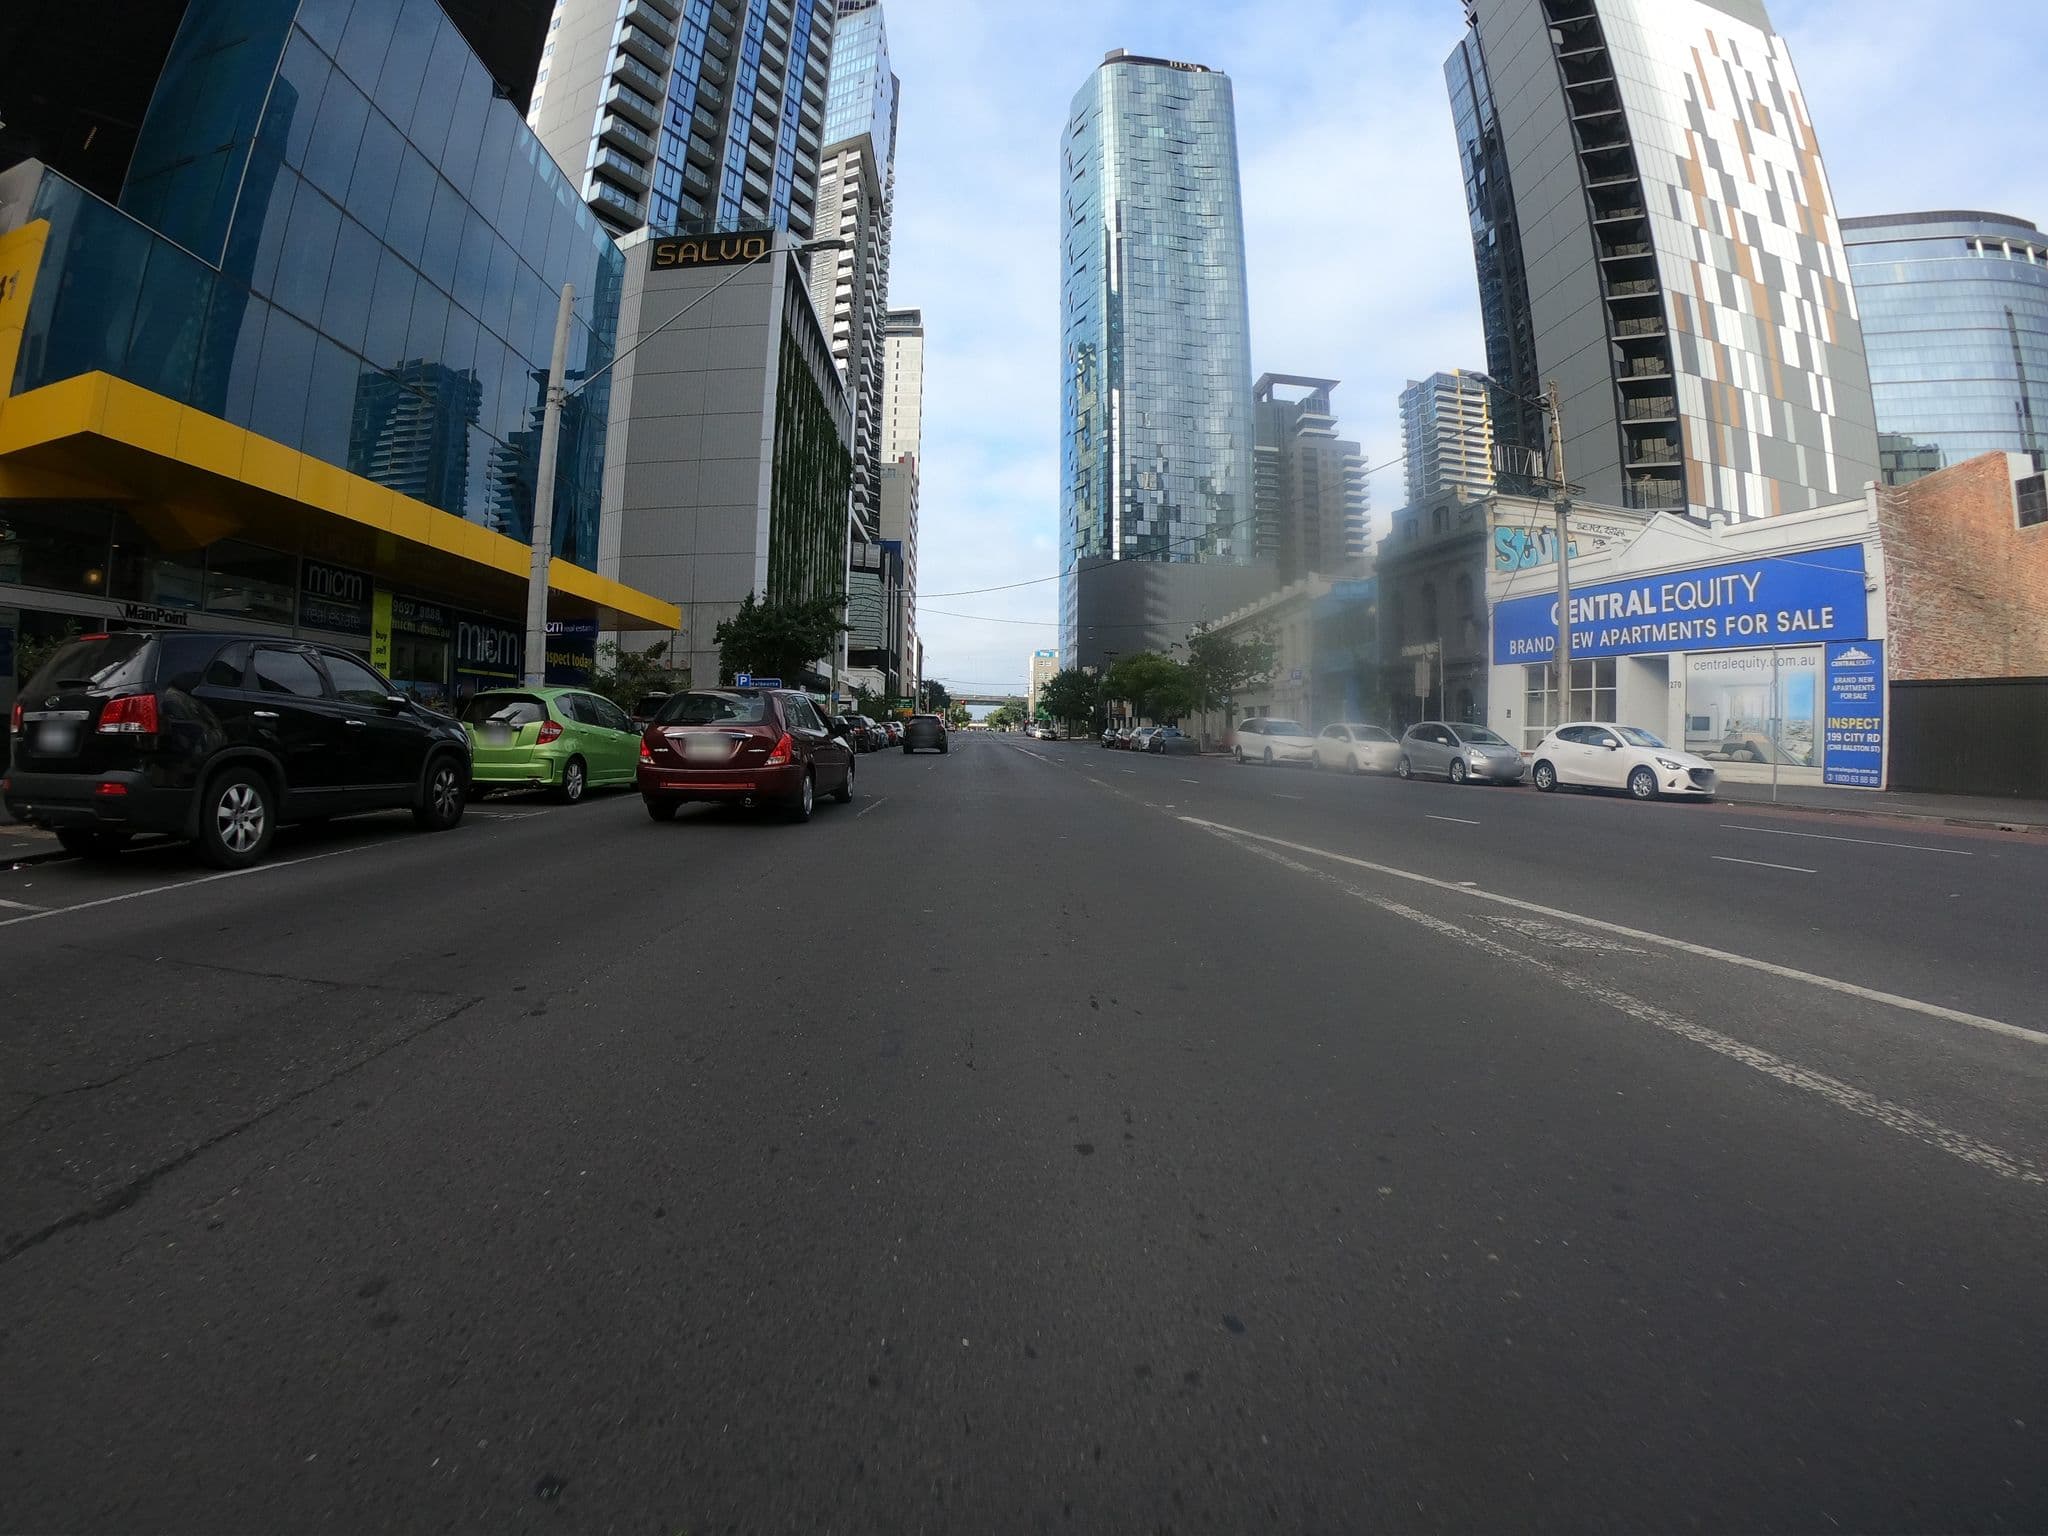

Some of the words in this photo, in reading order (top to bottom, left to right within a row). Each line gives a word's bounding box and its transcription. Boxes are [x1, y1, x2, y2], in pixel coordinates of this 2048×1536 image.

[656, 238, 766, 265] SALVO
[309, 564, 363, 600] micm
[125, 603, 188, 626] MainPoint
[1509, 636, 1555, 655] BRAND
[1570, 631, 1593, 649] EW
[1600, 619, 1717, 646] APARTMENTS
[1725, 613, 1768, 637] FOR
[1777, 607, 1834, 633] SALE
[1694, 656, 1816, 672] centralequity.com.au
[1828, 717, 1880, 730] INSPECT
[1828, 732, 1841, 742] 199
[1844, 733, 1865, 742] CITY
[1867, 733, 1880, 743] RD
